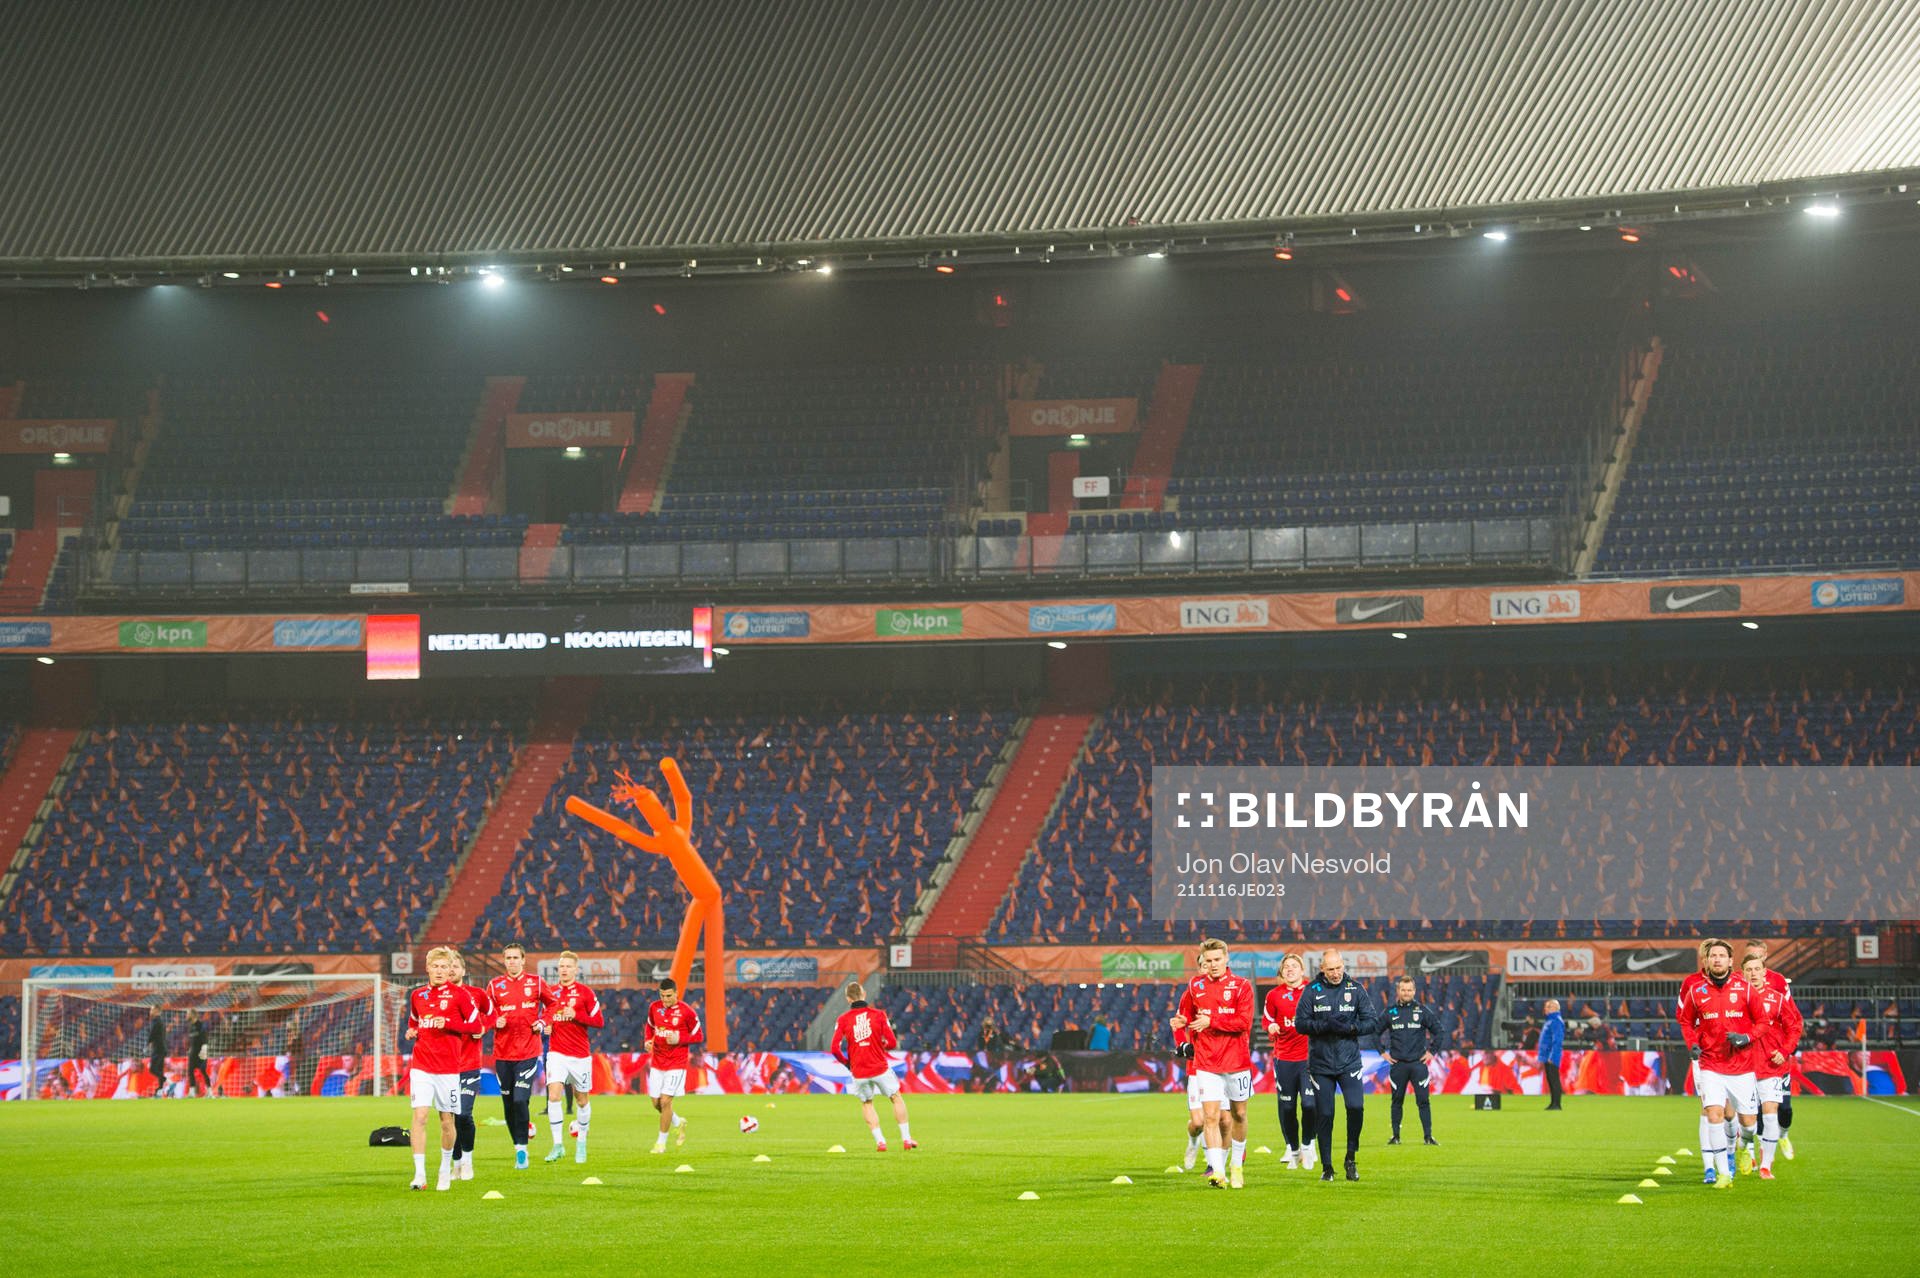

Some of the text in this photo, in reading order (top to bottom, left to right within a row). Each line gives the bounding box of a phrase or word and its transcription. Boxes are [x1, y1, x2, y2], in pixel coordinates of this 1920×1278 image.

[1083, 480, 1098, 494] FF
[1496, 597, 1541, 616] ING
[912, 613, 948, 631] kpn
[1185, 606, 1230, 625] ING
[157, 625, 193, 644] kpn
[428, 633, 547, 651] NEDERLAND
[564, 630, 693, 649] NOORWEGEN
[1863, 940, 1873, 954] E
[396, 956, 409, 970] G
[896, 949, 905, 963] F
[1513, 955, 1555, 972] ING
[1136, 957, 1171, 976] kpn
[418, 1017, 441, 1029] bam
[1238, 1076, 1249, 1091] 10
[450, 1089, 458, 1103] 5
